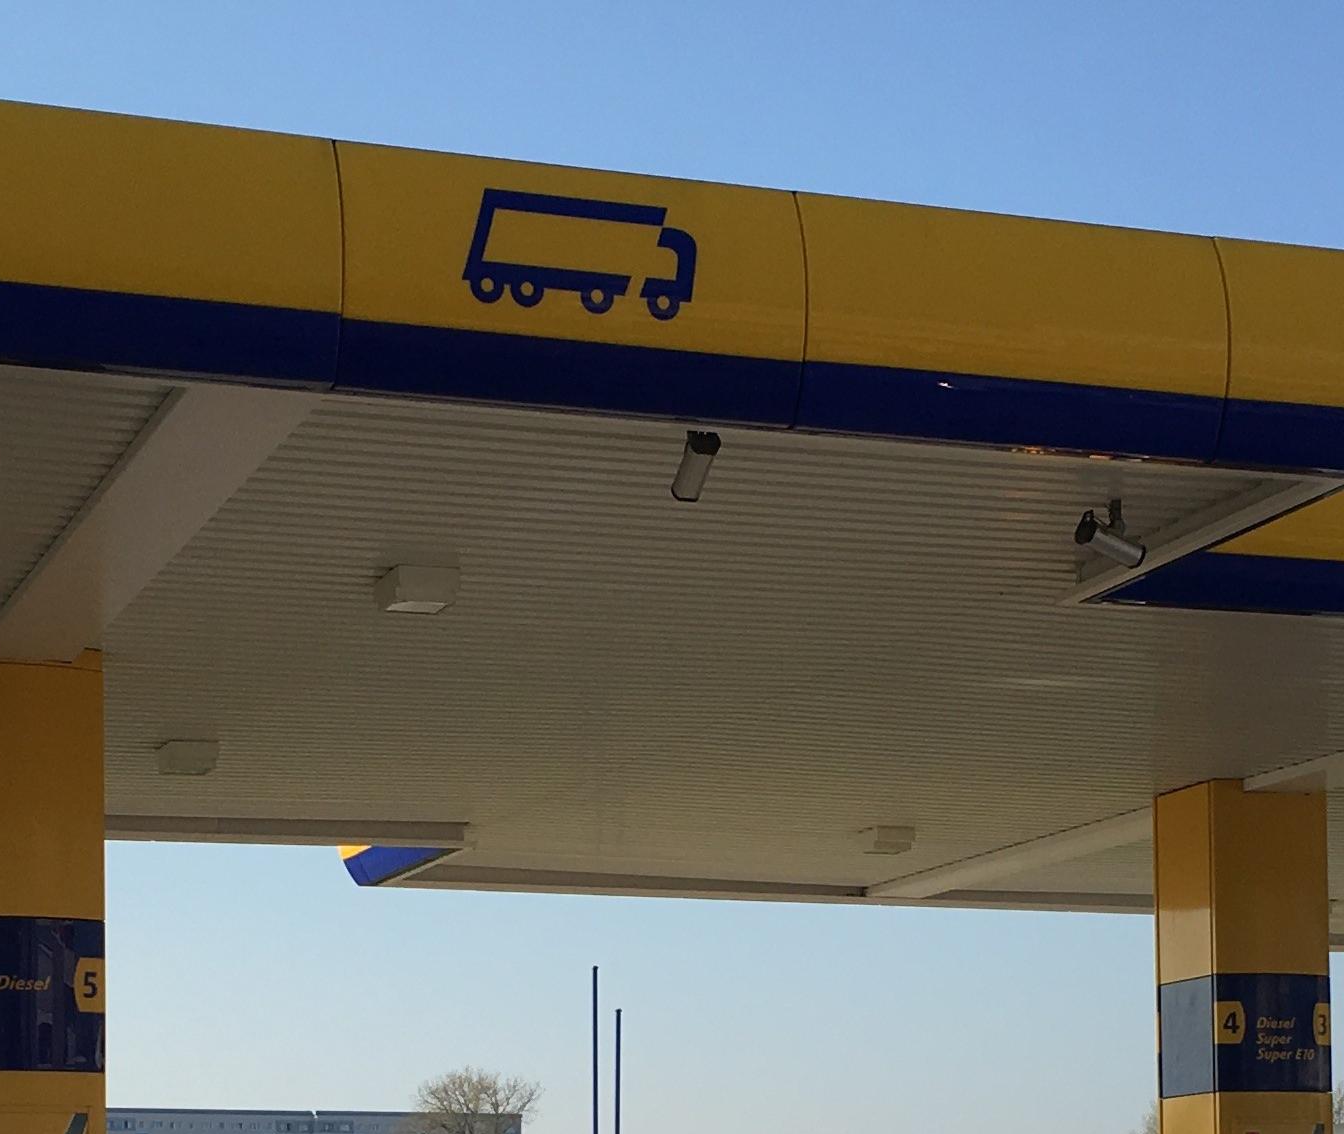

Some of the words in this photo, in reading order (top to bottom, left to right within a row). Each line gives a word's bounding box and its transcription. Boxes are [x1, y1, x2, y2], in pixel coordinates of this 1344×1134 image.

[83, 971, 98, 998] 5
[1223, 1010, 1240, 1034] 4
[1256, 1016, 1296, 1029] Diesel
[1317, 1013, 1327, 1035] 3
[1256, 1033, 1293, 1047] Super
[1256, 1048, 1294, 1063] Super
[1295, 1048, 1316, 1060] E10
